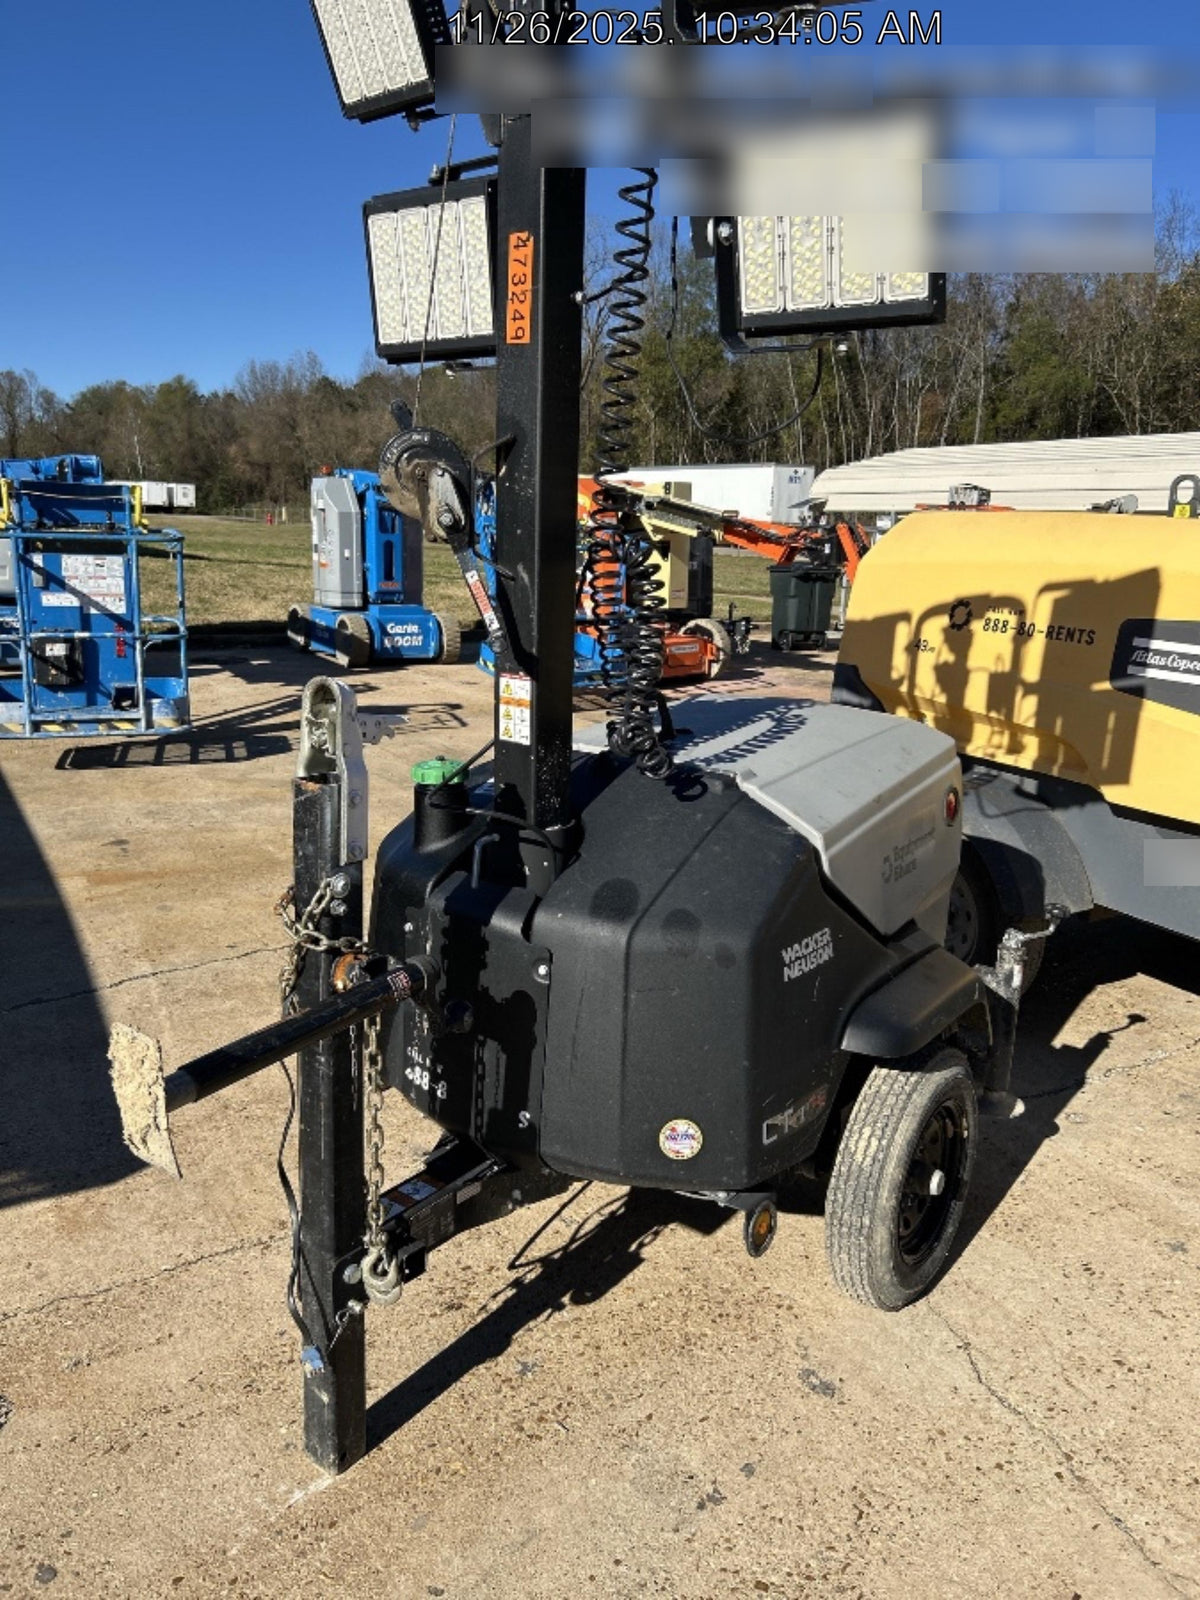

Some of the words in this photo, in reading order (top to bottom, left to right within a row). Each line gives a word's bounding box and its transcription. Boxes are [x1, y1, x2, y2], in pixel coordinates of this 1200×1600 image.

[386, 622, 419, 634] Genie
[983, 617, 1096, 646] 888-80-RENTS
[1130, 650, 1167, 666] Atlas
[781, 927, 832, 964] WACKER
[783, 941, 834, 982] NEUSON
